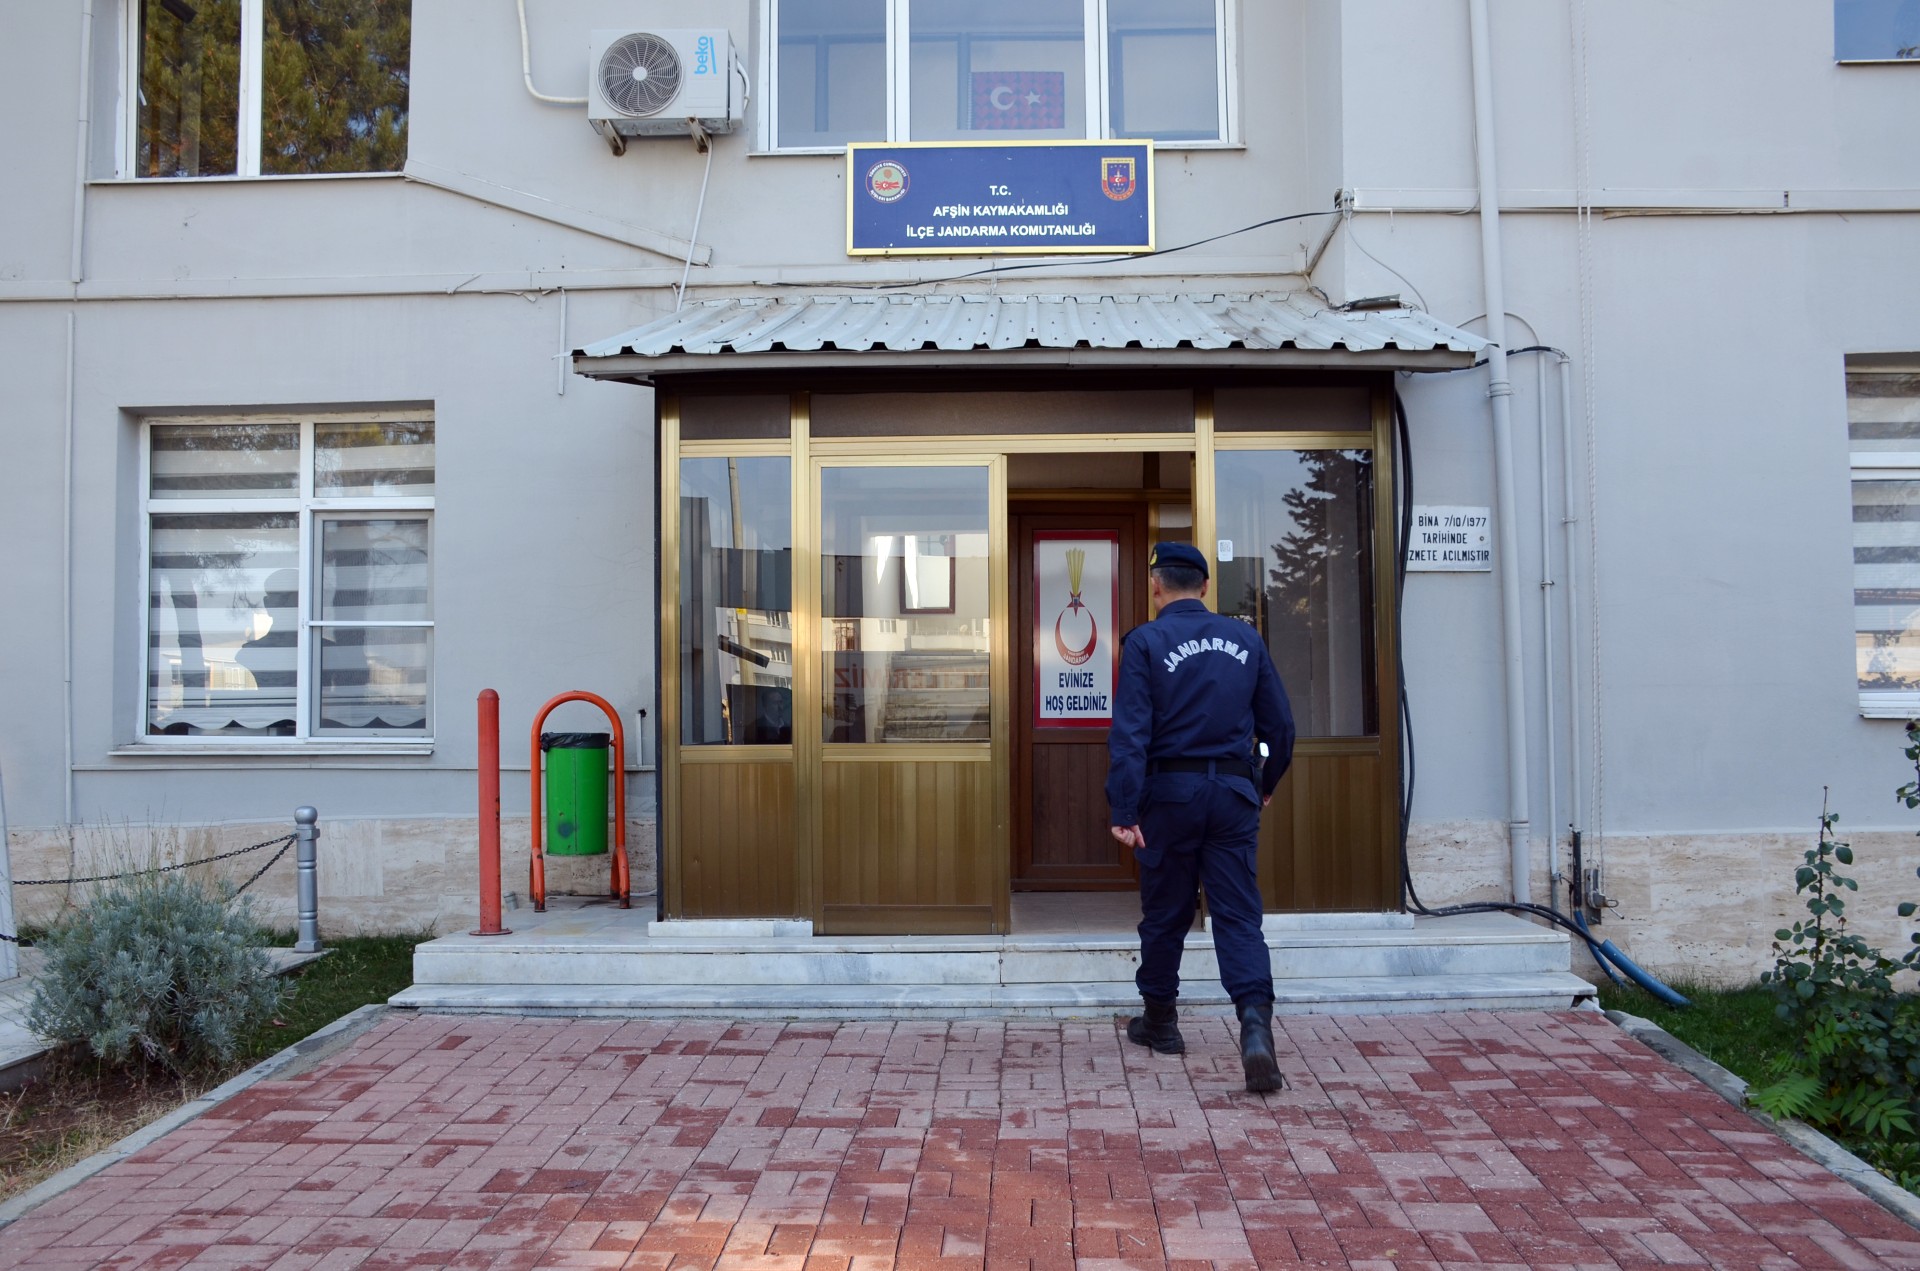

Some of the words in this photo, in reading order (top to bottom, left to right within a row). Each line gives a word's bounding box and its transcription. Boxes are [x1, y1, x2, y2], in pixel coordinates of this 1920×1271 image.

[694, 36, 708, 74] beko
[990, 185, 1011, 196] T.C.
[933, 204, 970, 218] AFŞİN
[973, 203, 1068, 217] KAYMAKAMLIĞI
[906, 224, 934, 239] İLÇE
[937, 225, 1007, 237] JANDARMA
[1010, 222, 1096, 236] KOMUTANLIĞI
[1418, 513, 1439, 527] BİNA
[1444, 514, 1487, 527] 7/10/1977
[1422, 530, 1468, 544] TARİHİNDE
[1163, 637, 1249, 673] JANDARMA
[1058, 668, 1094, 688] EVİNİZE
[1045, 695, 1064, 715] HOŞ
[1066, 692, 1108, 711] GELDİNİZ
